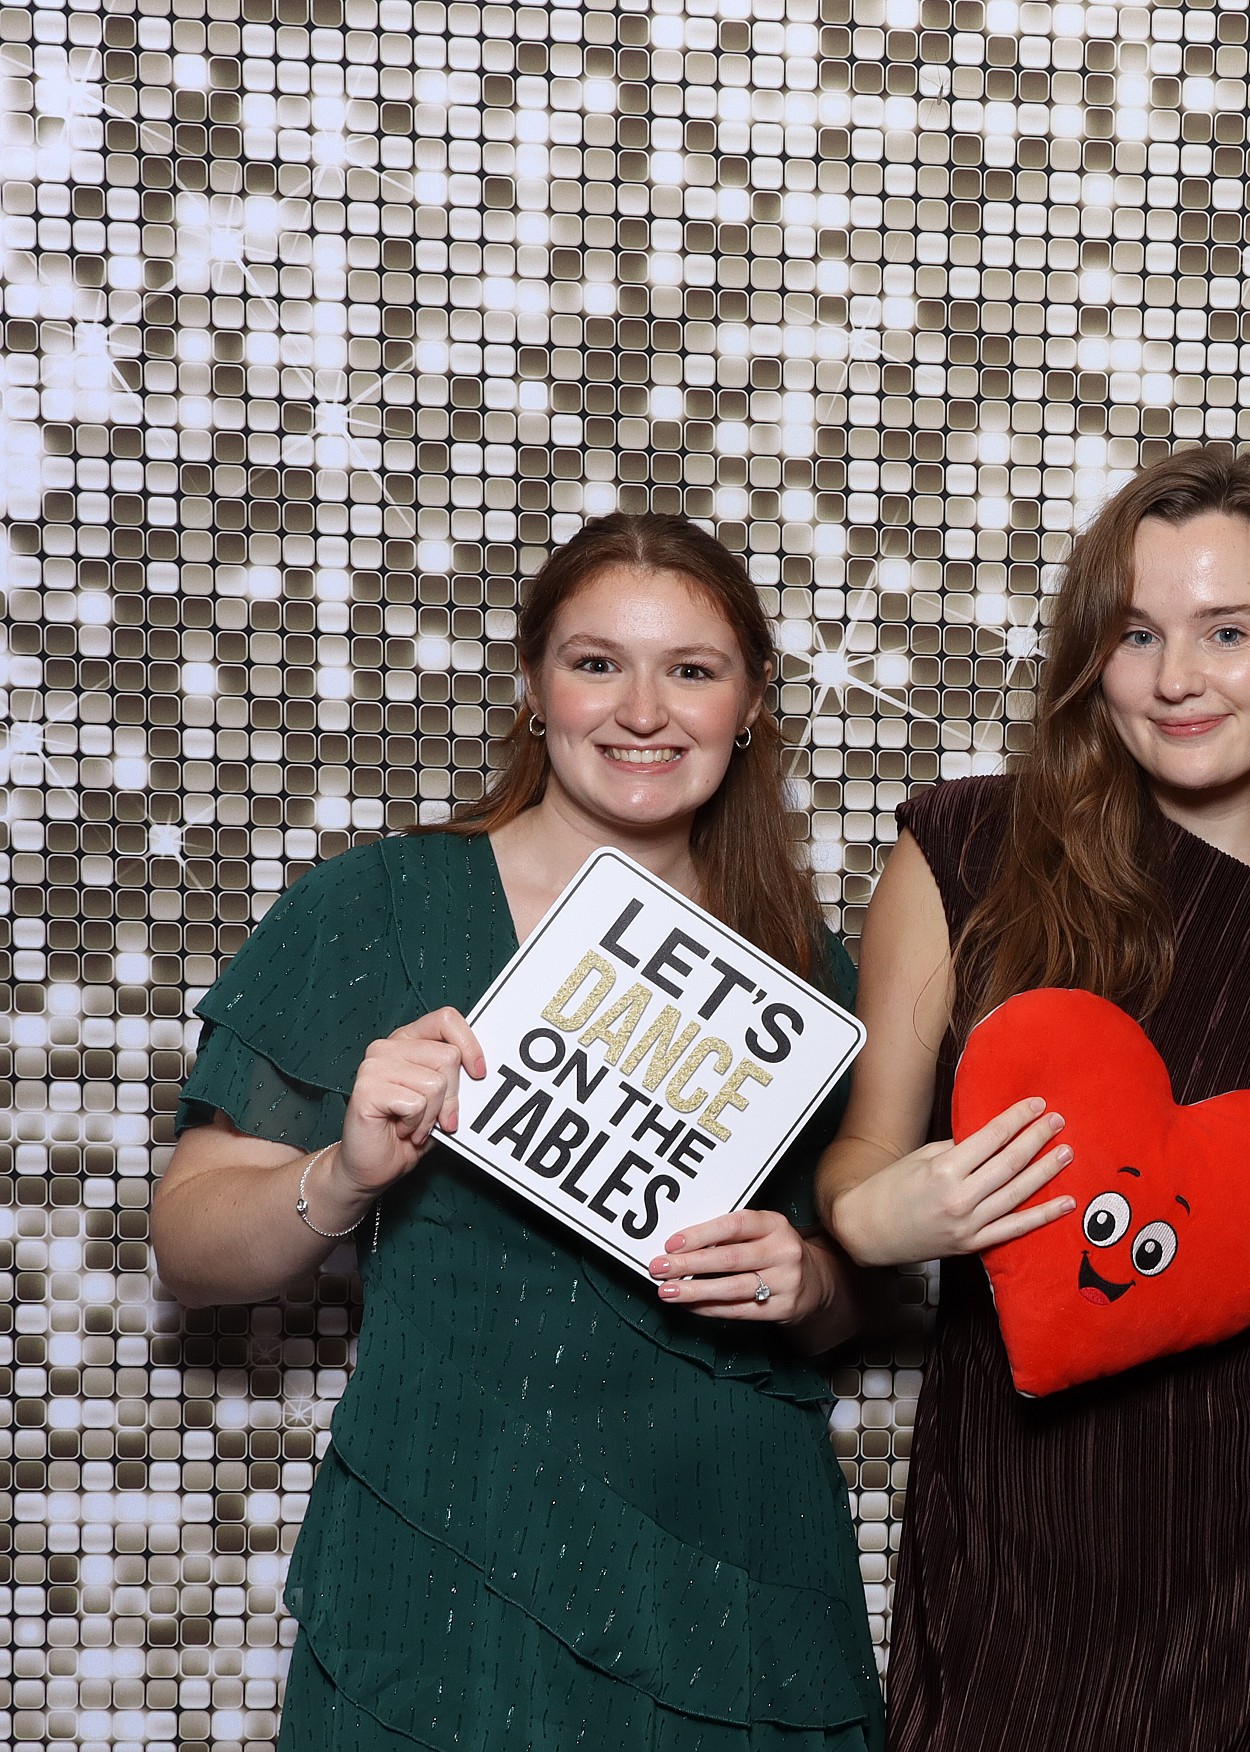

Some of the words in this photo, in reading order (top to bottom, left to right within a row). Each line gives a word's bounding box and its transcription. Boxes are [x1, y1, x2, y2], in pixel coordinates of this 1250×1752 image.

[540, 949, 774, 1143] DANCE
[599, 897, 805, 1064] LET'S
[469, 1063, 681, 1240] TABLES
[518, 1027, 609, 1105] ON
[608, 1081, 717, 1179] THE
